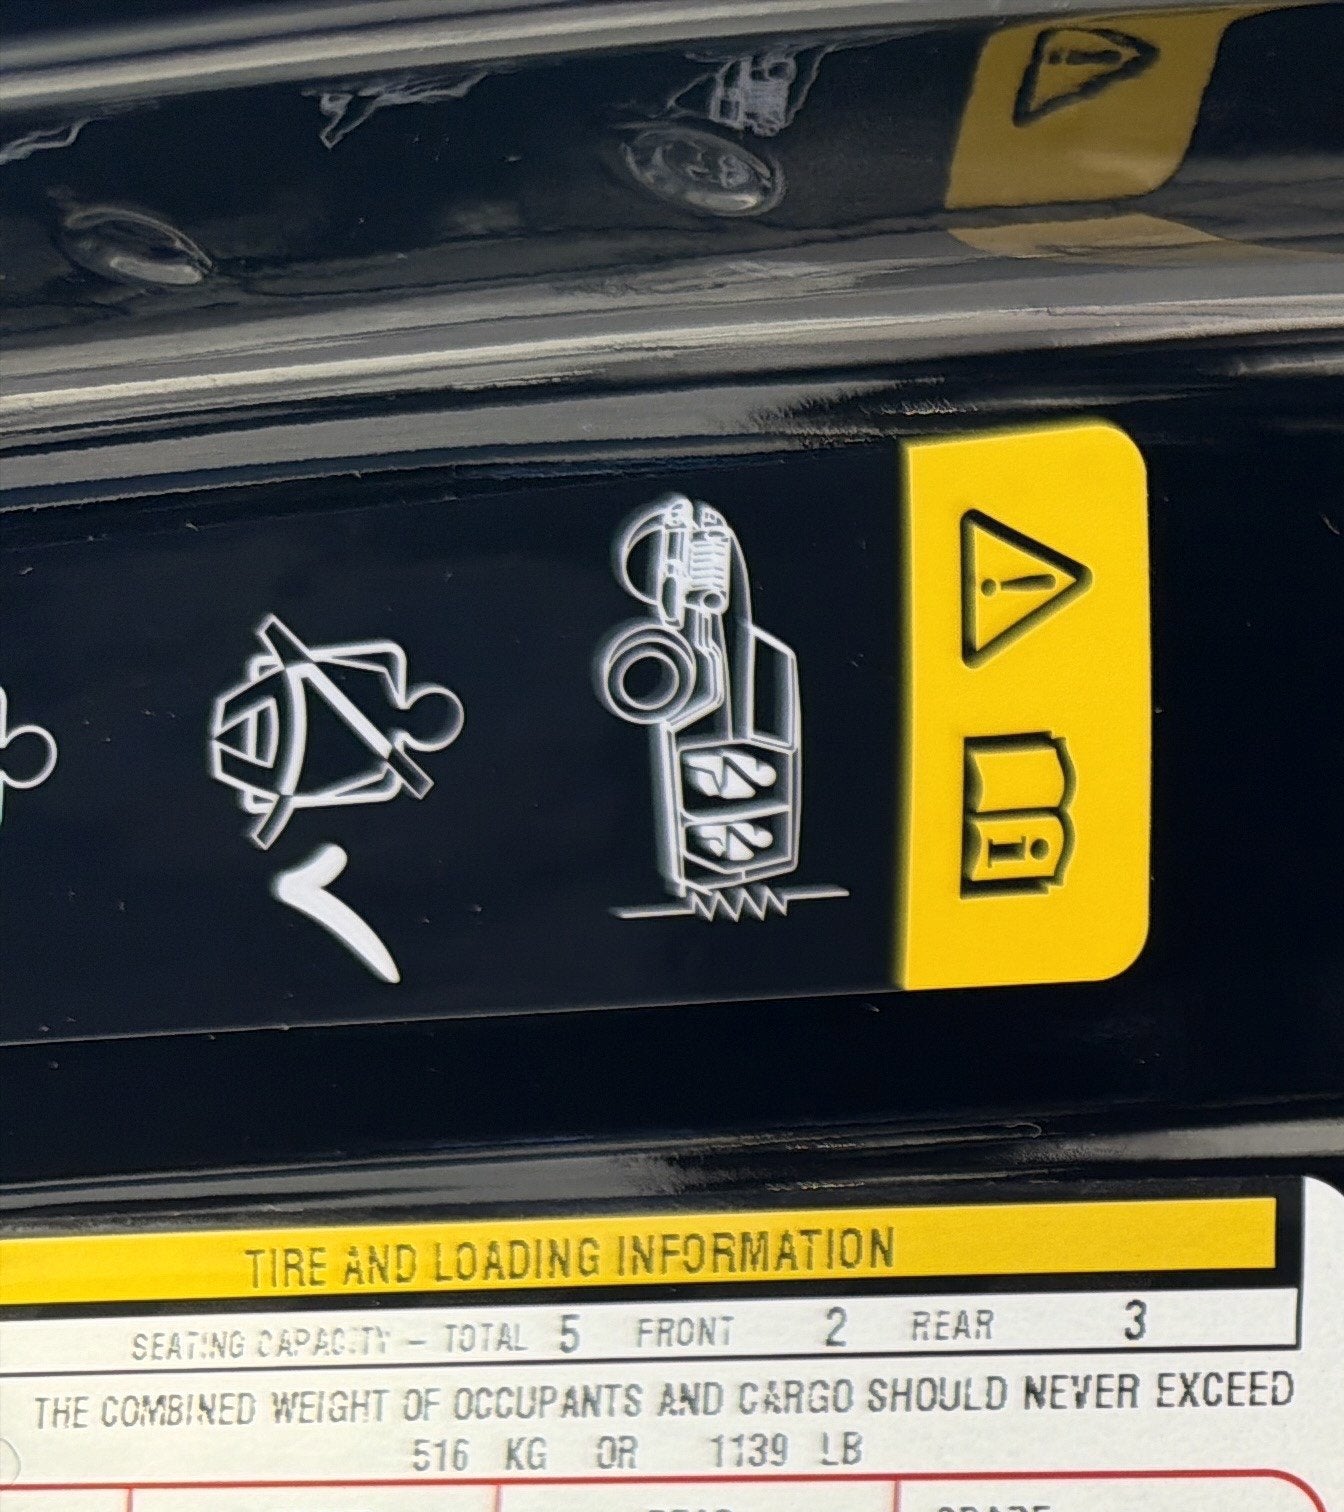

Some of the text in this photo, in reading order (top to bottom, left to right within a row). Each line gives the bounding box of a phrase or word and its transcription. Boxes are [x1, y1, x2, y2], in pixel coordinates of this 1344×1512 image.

[245, 1227, 894, 1287] TIRE AND LOADING INFORMATION
[132, 1331, 243, 1360] SEATING
[257, 1327, 390, 1358] CAPACITY
[444, 1323, 527, 1352] TOTAL
[560, 1315, 581, 1353] 5
[637, 1316, 735, 1349] FRONT
[825, 1307, 845, 1346] 2
[912, 1309, 993, 1340] REAR
[1125, 1299, 1146, 1340] 3
[35, 1371, 1293, 1429] THE COMBINED WEIGHT OF OCCUPANTS AND CARGO SHOULD NEVER EXCEED
[412, 1431, 862, 1471] 516 KG OR 1139 LB
